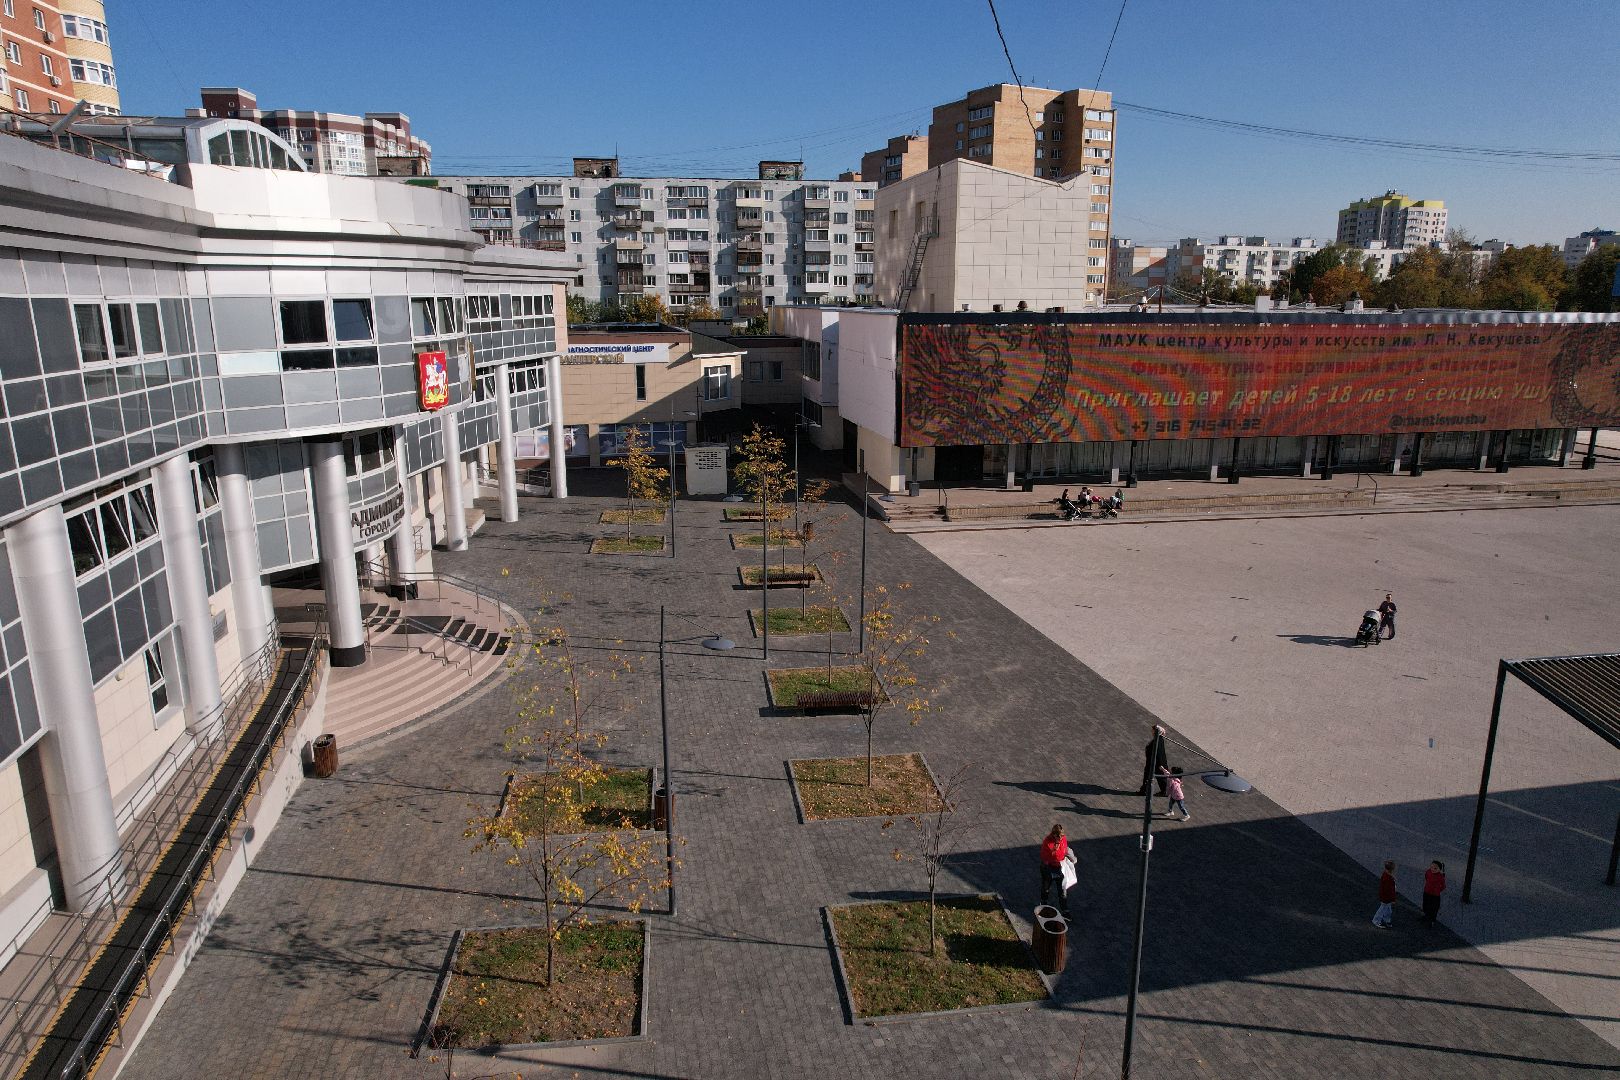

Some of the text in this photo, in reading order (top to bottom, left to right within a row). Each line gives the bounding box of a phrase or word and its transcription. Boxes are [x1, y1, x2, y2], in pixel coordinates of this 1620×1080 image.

[567, 345, 655, 354] АГНОСТИЧЕСКИЙ ЦЕНТР
[1098, 333, 1148, 347] МАУК
[1156, 336, 1206, 349] центр
[1215, 336, 1292, 349] культуры
[1299, 336, 1309, 347] и
[1315, 336, 1386, 349] искусств
[1392, 336, 1416, 347] им.
[1447, 333, 1461, 345] Н.
[1468, 333, 1540, 348] Кекушева
[1074, 388, 1223, 415] Приглашает
[1228, 384, 1298, 410] детей
[1305, 385, 1353, 404] 5-18
[1359, 388, 1398, 404] лет
[1402, 388, 1416, 402] в
[1425, 386, 1504, 407] секцию
[360, 518, 391, 538] ГОРОДА
